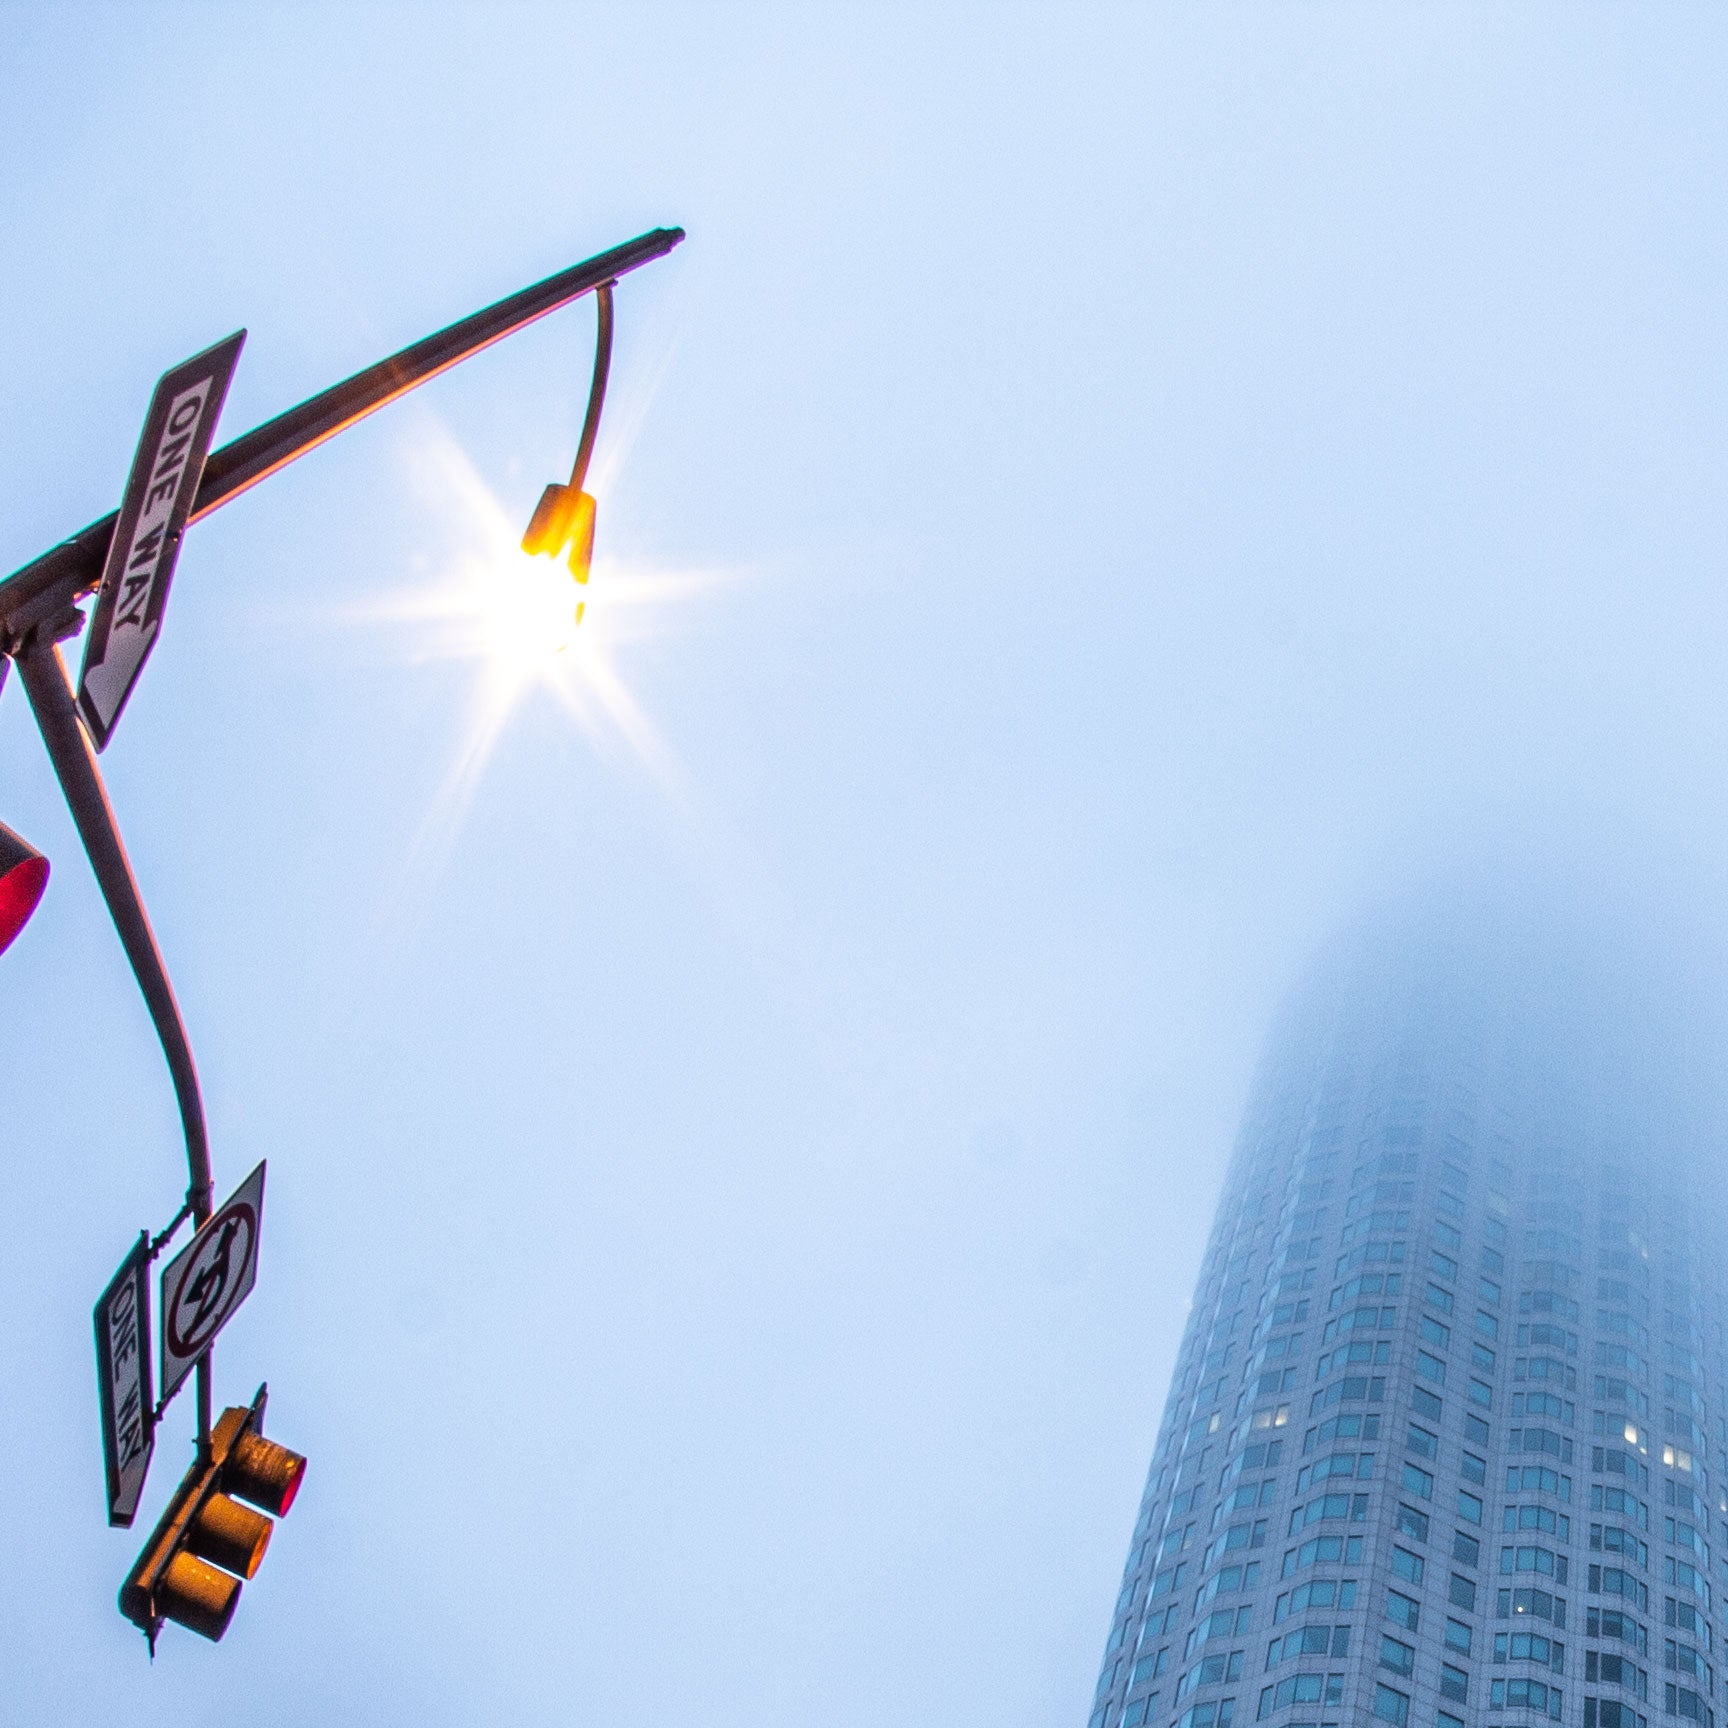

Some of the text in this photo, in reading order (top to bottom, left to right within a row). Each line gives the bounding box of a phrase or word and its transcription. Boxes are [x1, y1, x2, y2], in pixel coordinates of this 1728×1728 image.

[113, 395, 202, 632] ONE WAY
[111, 1281, 142, 1473] ONE WAY
